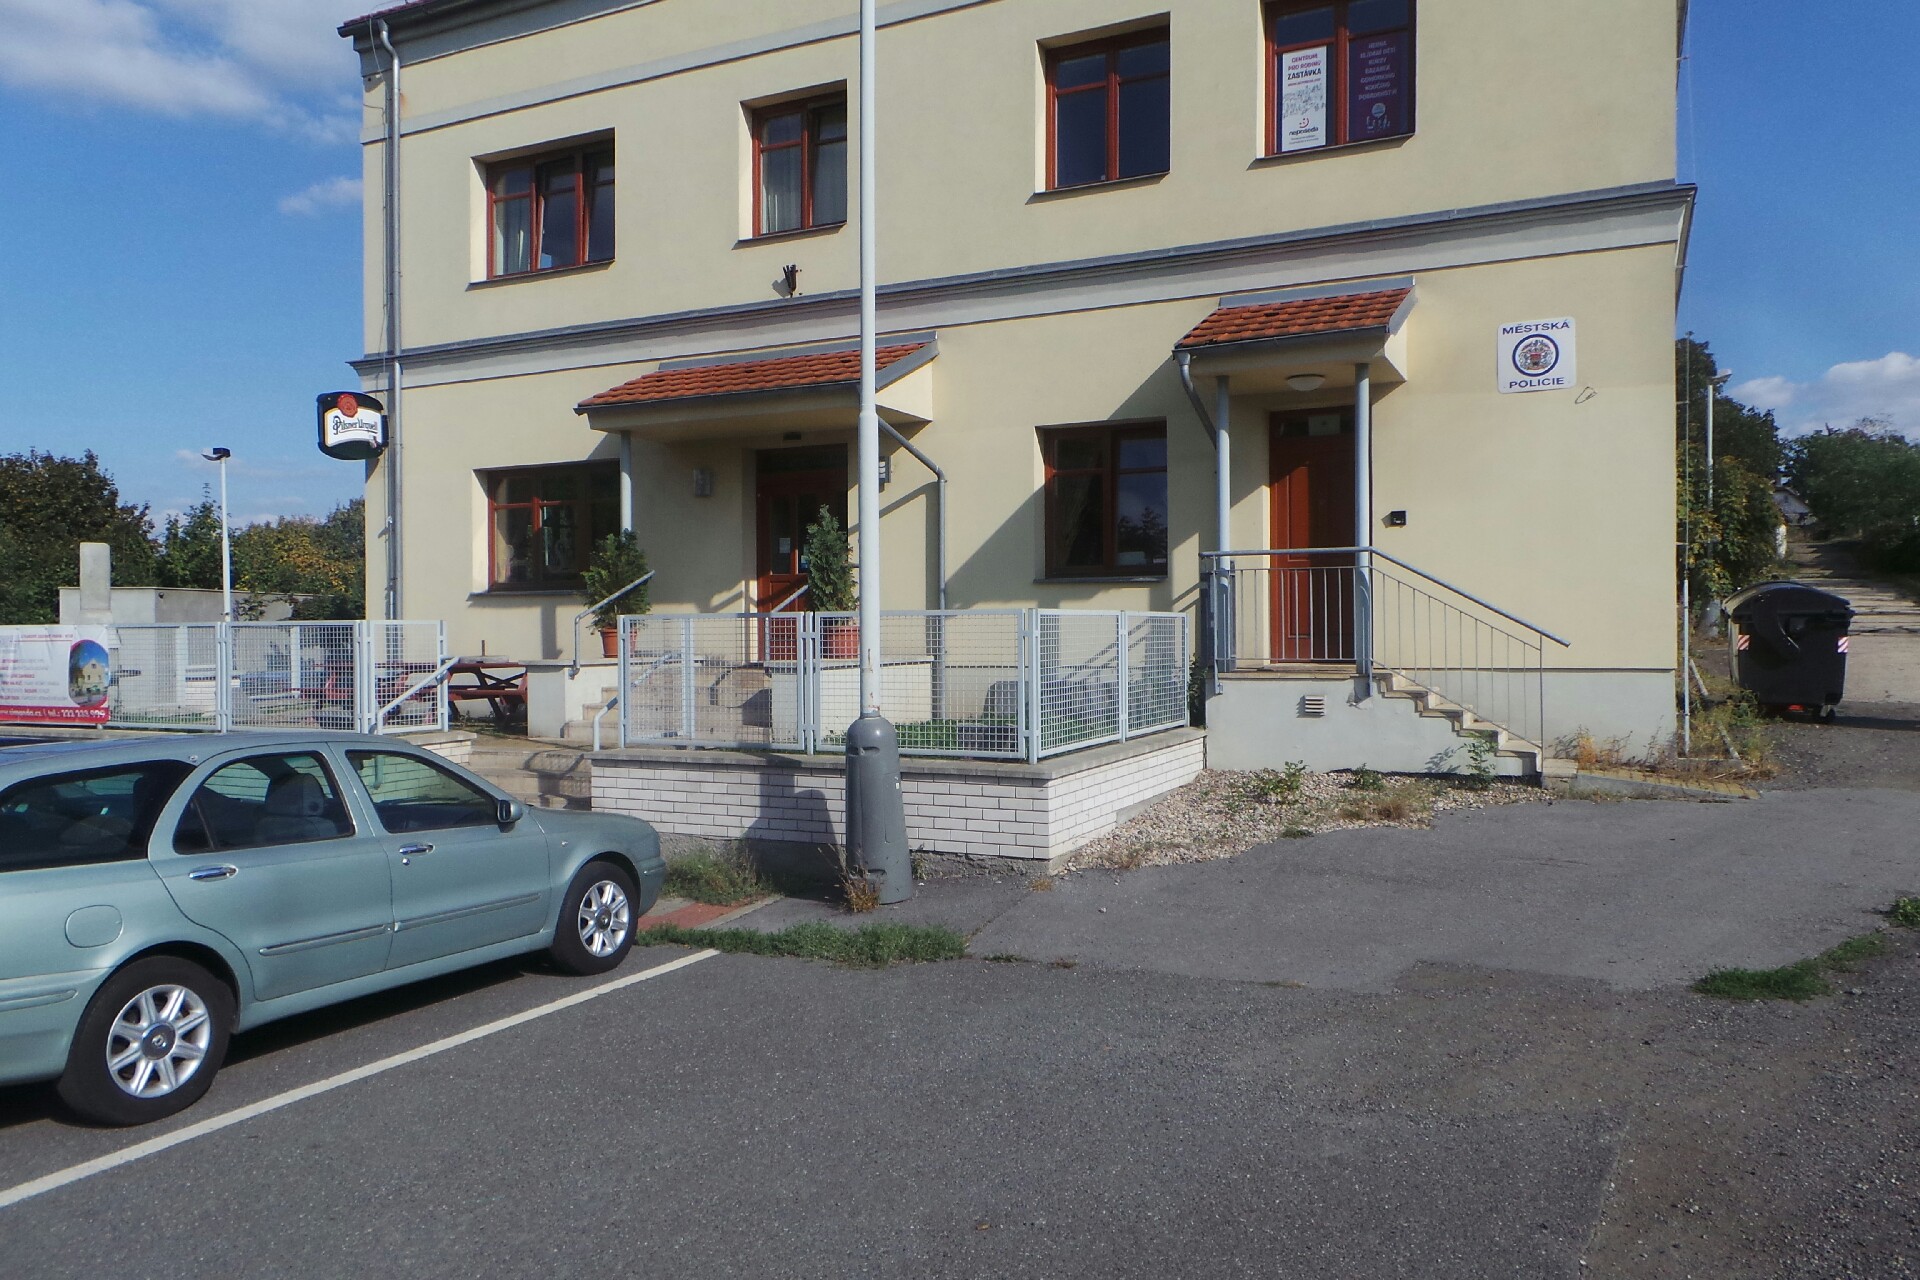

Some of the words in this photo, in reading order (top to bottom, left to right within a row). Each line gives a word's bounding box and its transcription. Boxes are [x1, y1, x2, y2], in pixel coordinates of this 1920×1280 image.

[1291, 53, 1318, 63] CENTRUM
[1287, 68, 1322, 80] ZASTÁVKA
[1502, 319, 1570, 335] MĚSTSKÁ
[1509, 377, 1565, 389] POLICIE
[333, 415, 358, 436] Pilsner
[358, 417, 378, 431] Urquell
